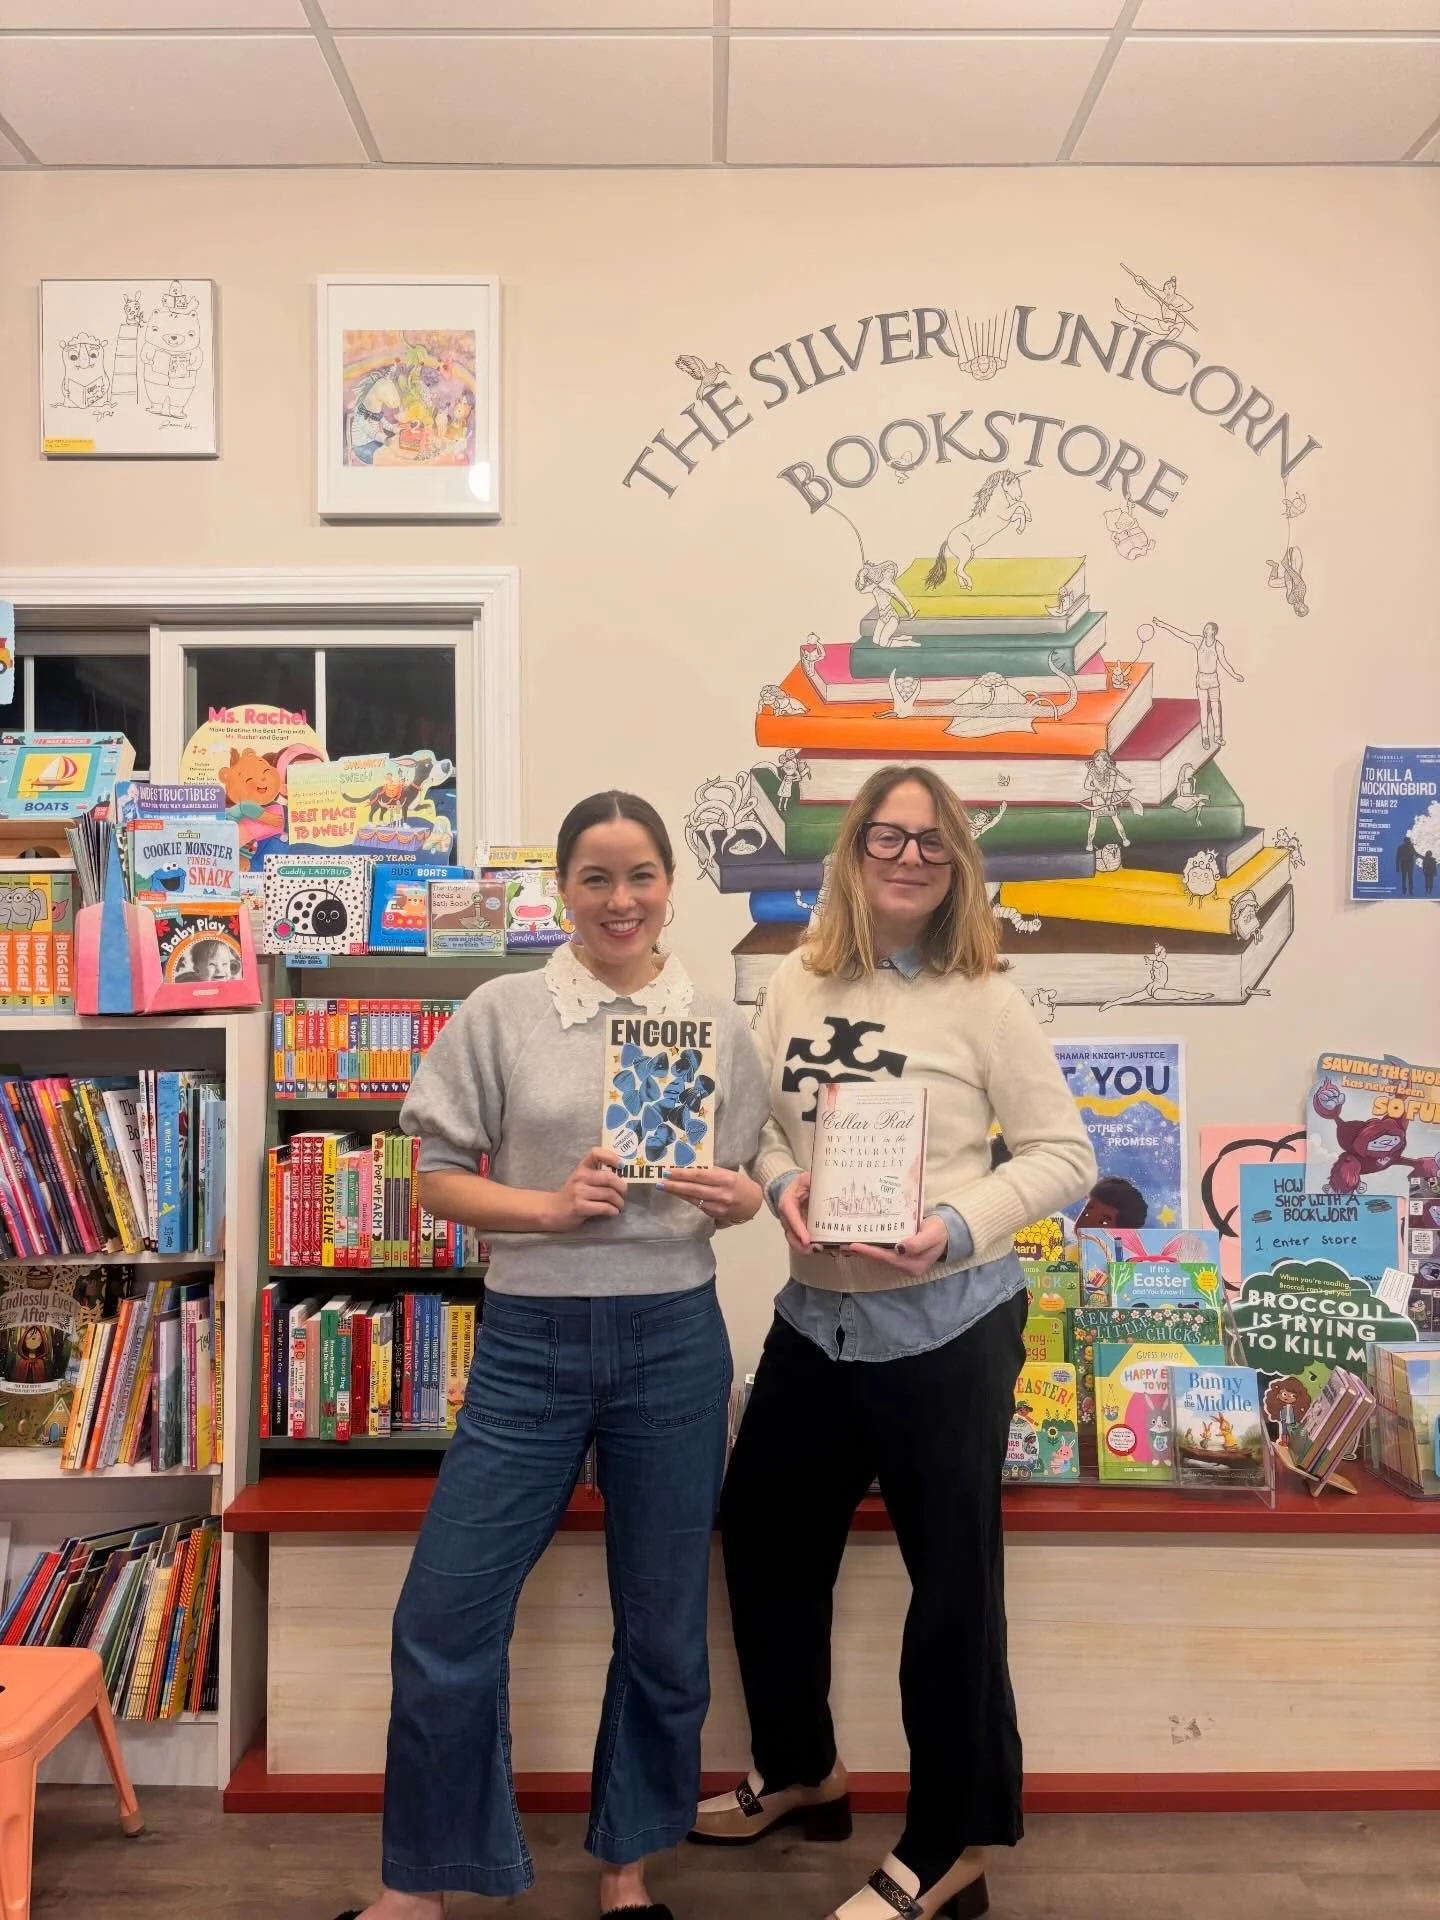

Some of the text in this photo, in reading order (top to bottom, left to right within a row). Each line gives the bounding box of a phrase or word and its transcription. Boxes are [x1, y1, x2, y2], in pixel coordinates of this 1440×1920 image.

[622, 304, 1323, 499] THE SILVER UNICORN
[776, 409, 1190, 518] BOOKSTORE
[208, 706, 308, 725] Ms. Rachel
[1366, 767, 1413, 781] TO KILL A
[1361, 781, 1437, 796] MOCKINGBIRD
[24, 802, 69, 811] BOATS
[291, 806, 357, 823] BEST PLACE
[294, 822, 354, 840] TO DWELL!
[143, 841, 233, 860] COOKIE MONSTER
[187, 856, 217, 866] FINDS A
[188, 867, 234, 888] SNACK
[280, 866, 349, 876] Cuddly LADYBUG
[391, 868, 448, 877] BUSY BOATS
[160, 918, 226, 953] Baby Play
[510, 933, 535, 944] Sandra
[16, 941, 32, 992] BIGGIE!
[35, 941, 50, 992] BIGGIE!
[56, 941, 71, 992] BIGGIE!
[349, 1020, 357, 1043] Egypt
[611, 1019, 712, 1049] ENCORE
[1092, 1052, 1166, 1060] KNIGHT-JUSTICE
[1322, 1056, 1377, 1076] SAVING
[1380, 1064, 1409, 1080] THE
[1091, 1066, 1170, 1095] YOU
[1342, 1077, 1425, 1098] has never been
[1372, 1096, 1405, 1119] SO
[821, 1109, 916, 1130] Cellar Rat
[164, 1128, 172, 1153] WHALE
[620, 1139, 635, 1153] COPY
[827, 1135, 842, 1143] MY
[850, 1135, 876, 1143] LIFE
[1108, 1136, 1160, 1147] PROMISE
[825, 1147, 906, 1155] RESTAURANT
[164, 1156, 171, 1168] OF
[824, 1158, 904, 1168] UNDERBELLY
[164, 1178, 172, 1196] TIME
[1274, 1178, 1304, 1193] HOW
[323, 1173, 334, 1244] MADELINE
[1275, 1194, 1360, 1207] SHOP WITH A
[372, 1196, 383, 1229] FARM
[815, 1220, 905, 1232] HANNAH SELINGER
[1149, 1265, 1157, 1273] If
[1133, 1272, 1190, 1288] Easter
[1279, 1273, 1351, 1290] When you're reading,
[1279, 1282, 1352, 1298] Broccoli can't get you!
[0, 1291, 73, 1313] Endlessly Ever
[1248, 1290, 1383, 1320] BROCCOLI
[21, 1308, 50, 1322] After
[1077, 1311, 1109, 1328] TEN
[1096, 1315, 1151, 1339] LITTLE
[1146, 1327, 1201, 1343] CHICKS
[1252, 1312, 1376, 1341] IS TRYING
[404, 1341, 412, 1370] TRAINS
[1026, 1347, 1047, 1360] egg
[1136, 1351, 1158, 1360] GUESS
[1247, 1333, 1367, 1363] TO KILL M
[1124, 1368, 1158, 1382] HAPPY
[1188, 1371, 1244, 1392] Bunny
[1015, 1377, 1074, 1408] EASTER!
[1144, 1382, 1155, 1390] TO
[1184, 1400, 1196, 1408] the
[1197, 1394, 1252, 1412] Middle
